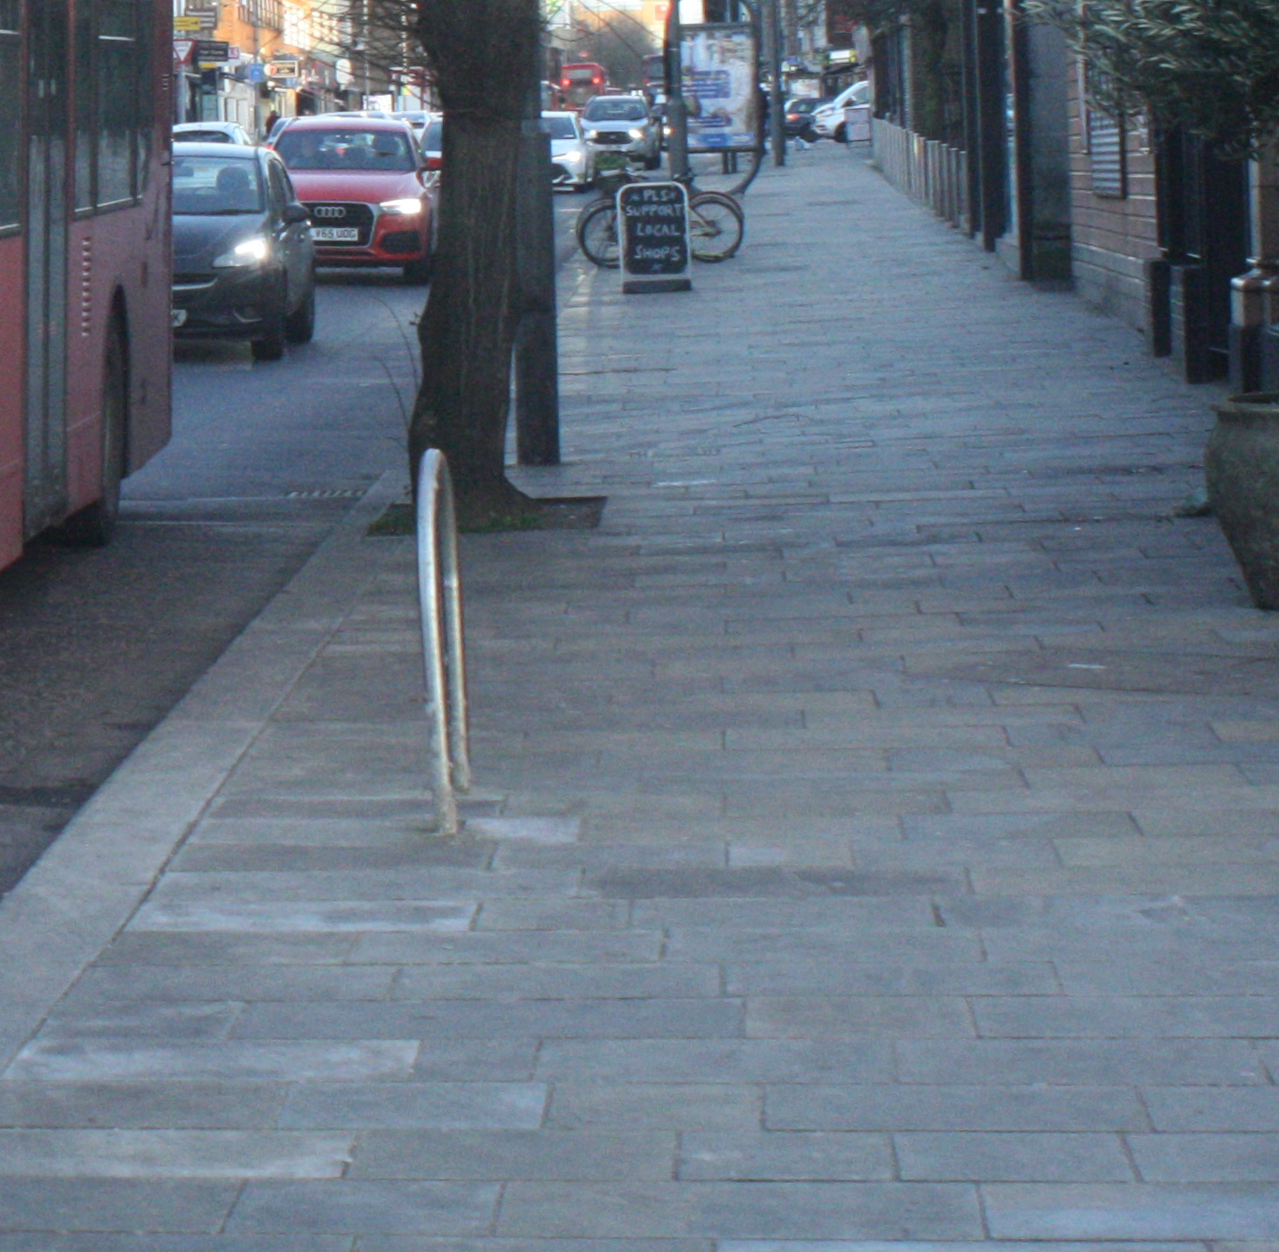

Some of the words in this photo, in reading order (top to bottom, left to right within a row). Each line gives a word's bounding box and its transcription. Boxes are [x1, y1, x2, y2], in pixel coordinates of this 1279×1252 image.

[626, 203, 683, 216] SUPPORT
[636, 223, 681, 236] LOCAL
[634, 245, 681, 261] SHOPS
